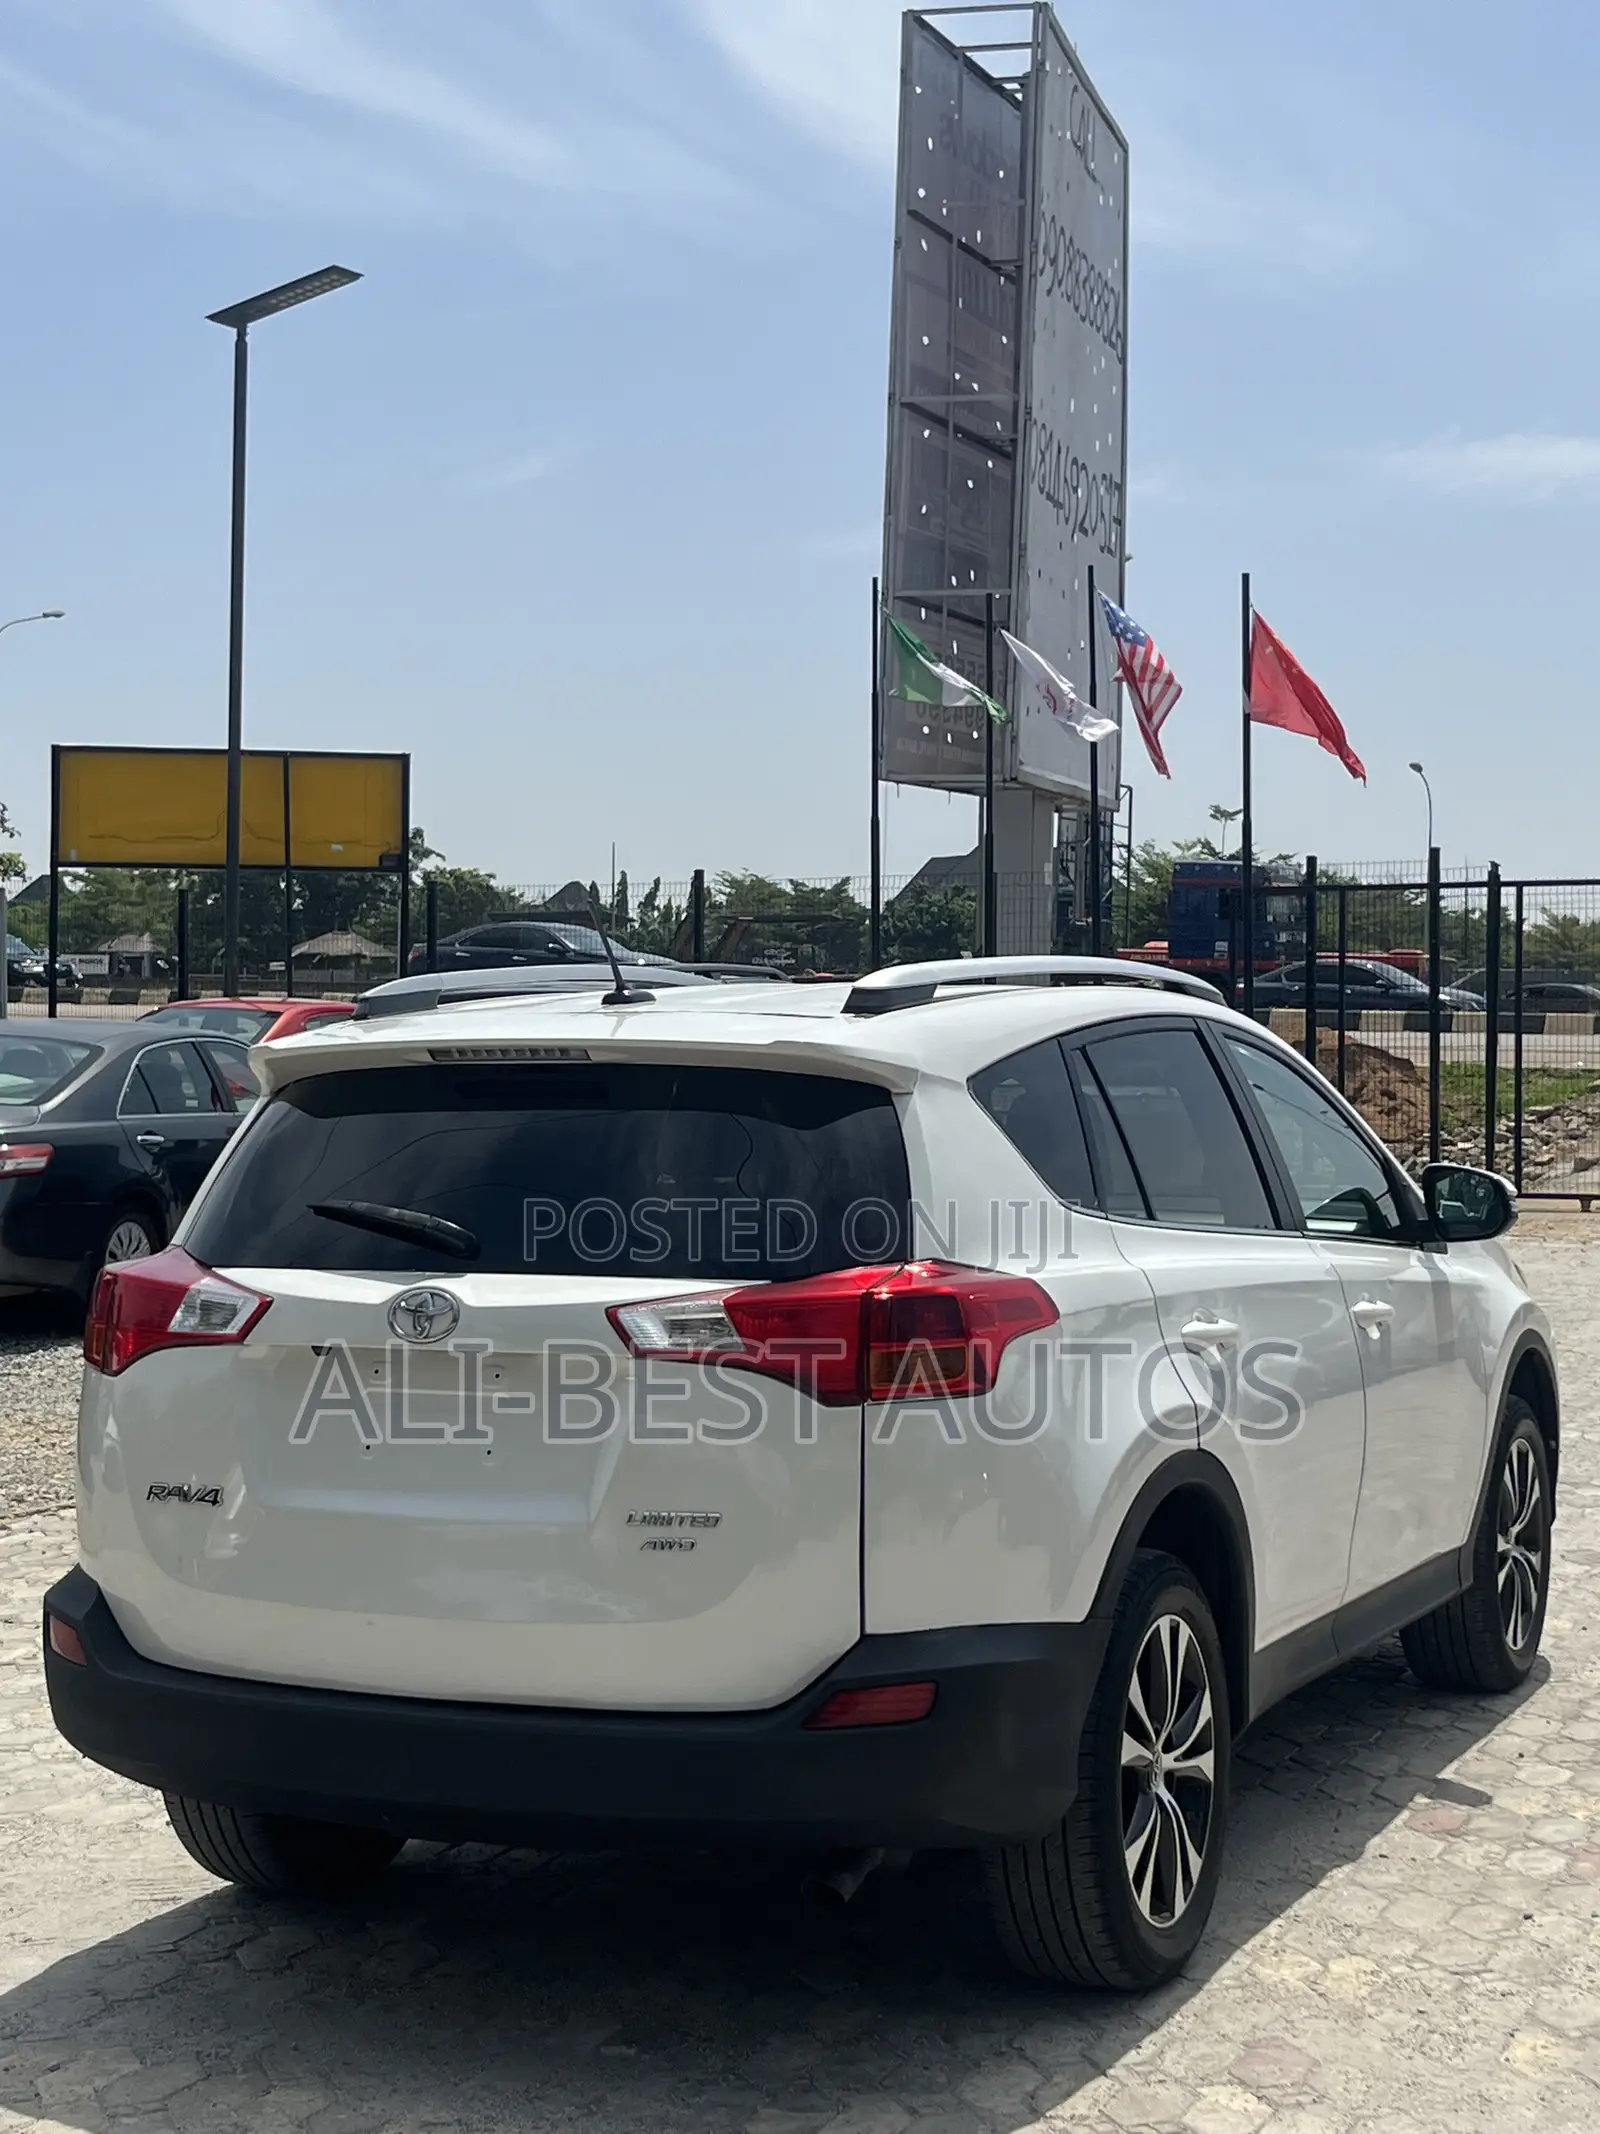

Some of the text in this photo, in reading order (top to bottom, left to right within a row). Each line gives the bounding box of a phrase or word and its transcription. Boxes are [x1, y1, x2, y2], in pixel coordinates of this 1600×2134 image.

[146, 1482, 224, 1506] RAV4
[626, 1510, 722, 1528] LIMITED
[640, 1537, 697, 1552] AWD
